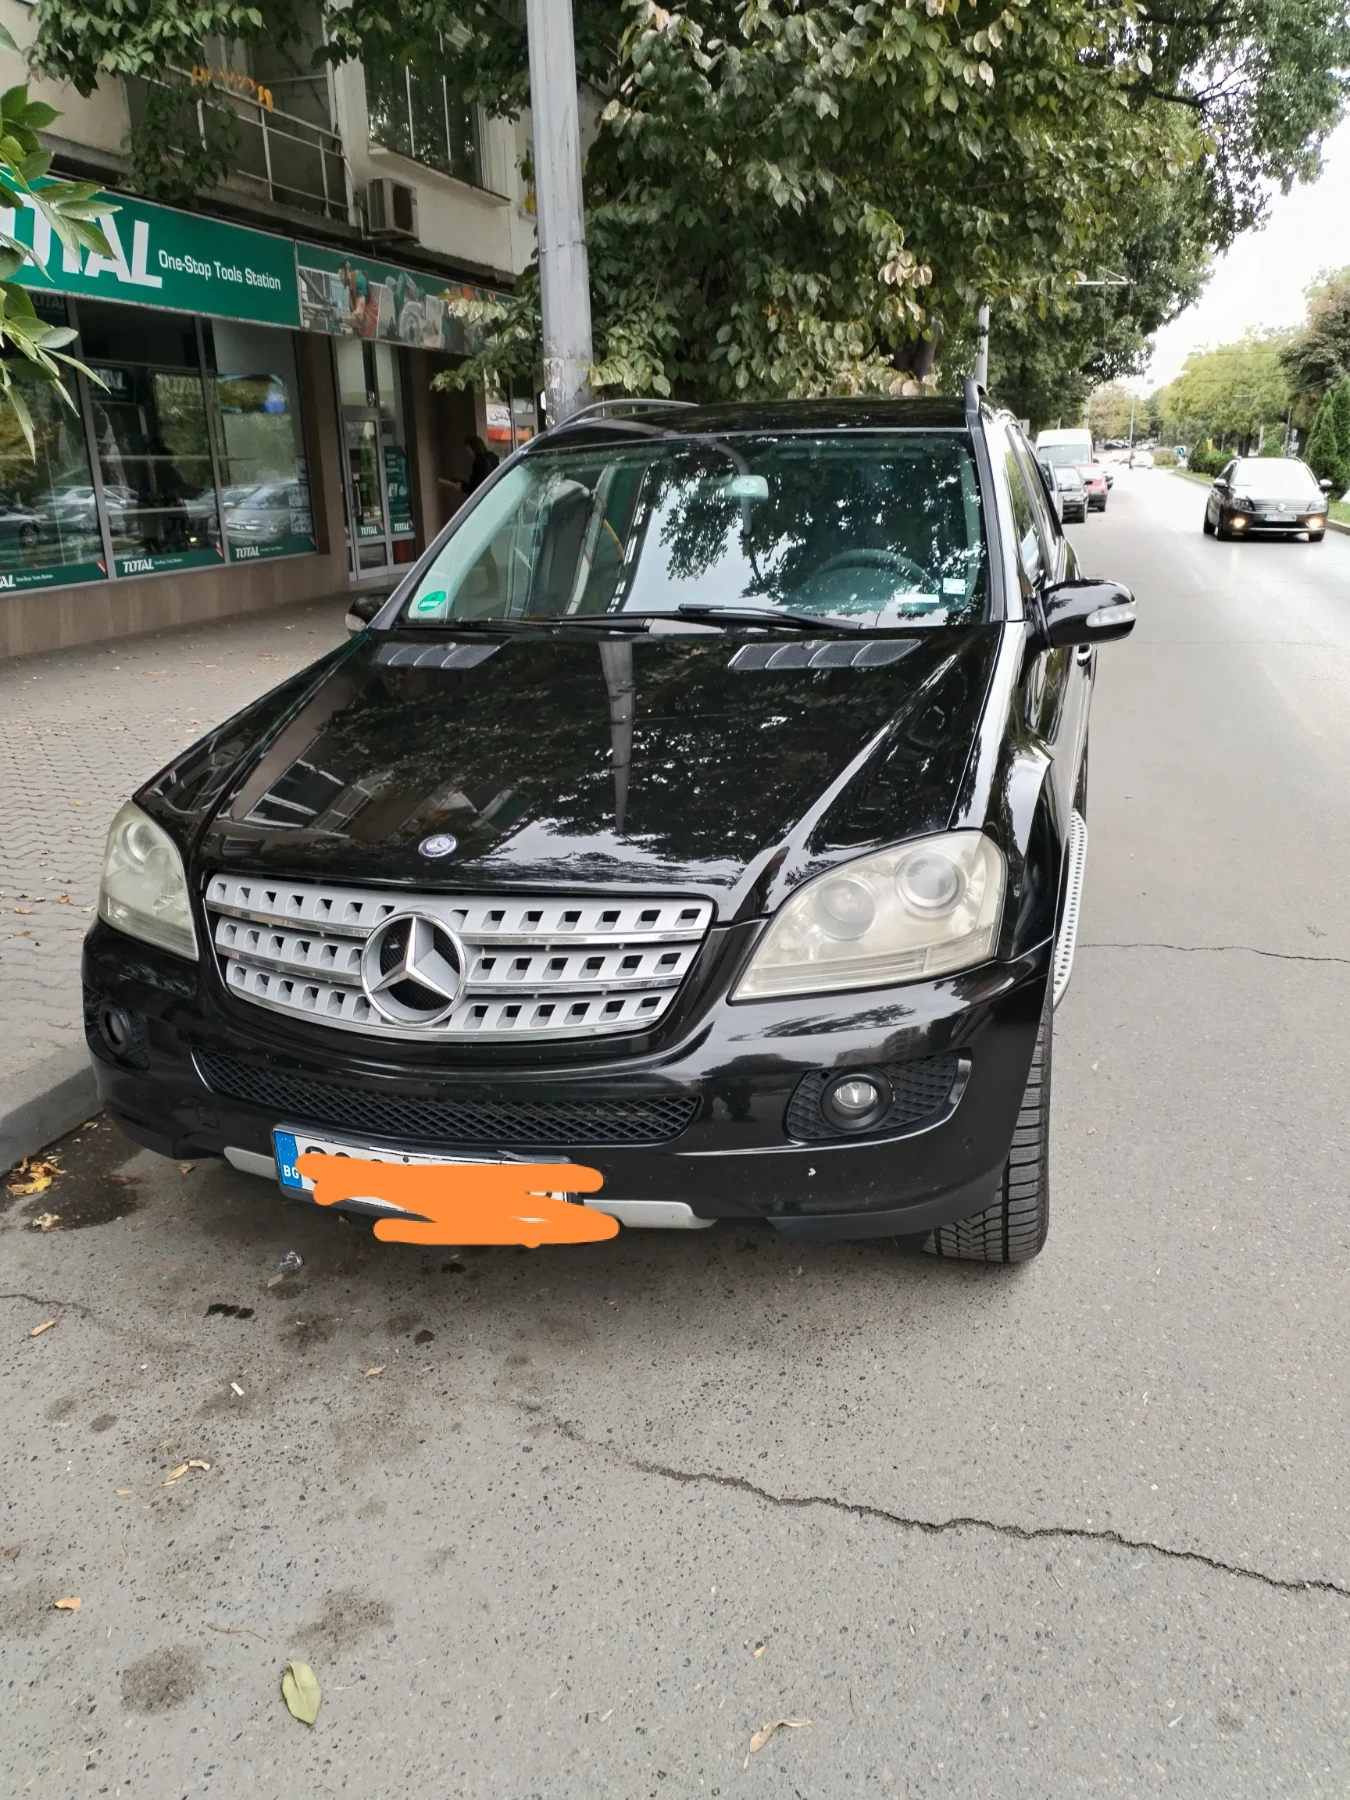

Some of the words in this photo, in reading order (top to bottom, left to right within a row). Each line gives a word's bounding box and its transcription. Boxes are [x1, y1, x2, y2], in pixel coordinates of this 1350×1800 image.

[159, 250, 211, 281] One-Stop
[214, 261, 242, 283] Tools
[245, 268, 281, 291] Station
[361, 526, 378, 536] TOTAL
[394, 522, 410, 531] TOTAL
[235, 546, 260, 558] TOTAL
[122, 558, 154, 573] TOTAL
[283, 1164, 300, 1179] BG
